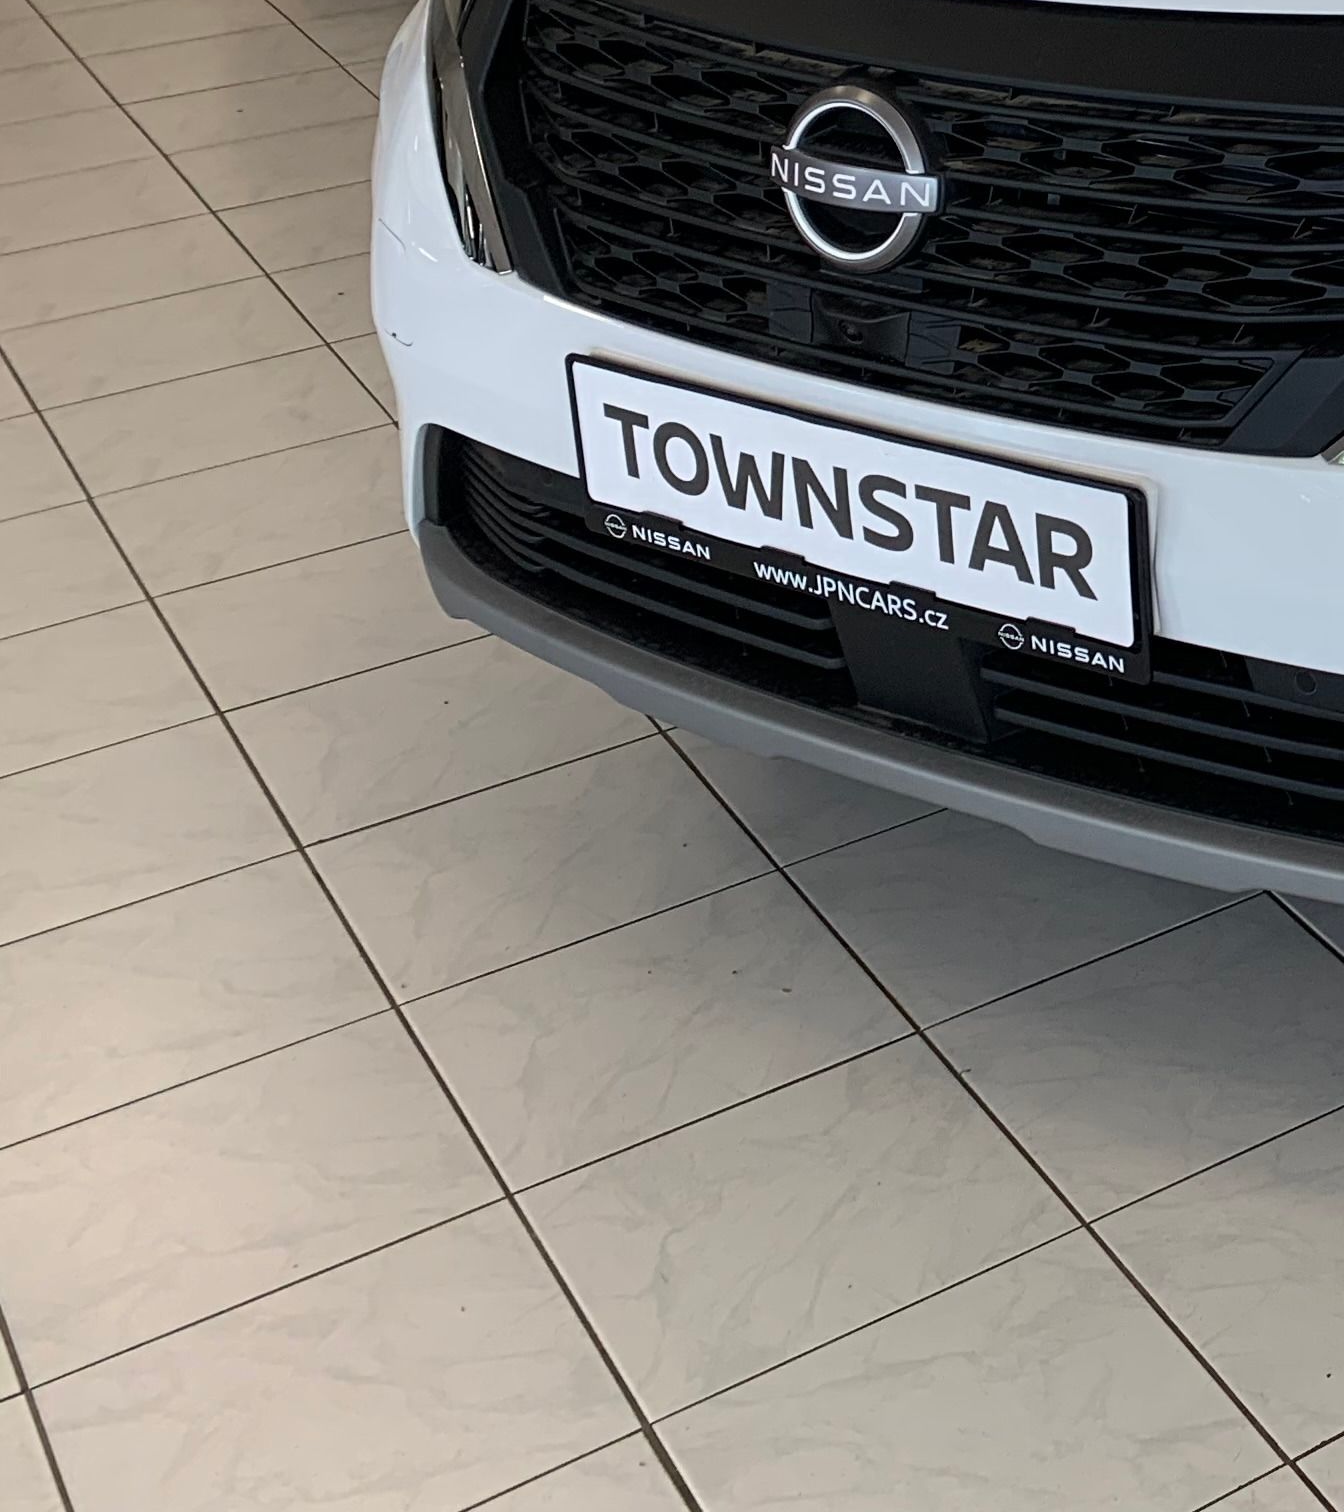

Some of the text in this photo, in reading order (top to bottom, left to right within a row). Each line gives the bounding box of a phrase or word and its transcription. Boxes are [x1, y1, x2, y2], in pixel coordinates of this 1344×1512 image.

[771, 152, 929, 207] NISSAN
[603, 403, 1099, 602] TOWNSTAR
[632, 524, 711, 560] NISSAN
[1030, 635, 1125, 674] NISSAN
